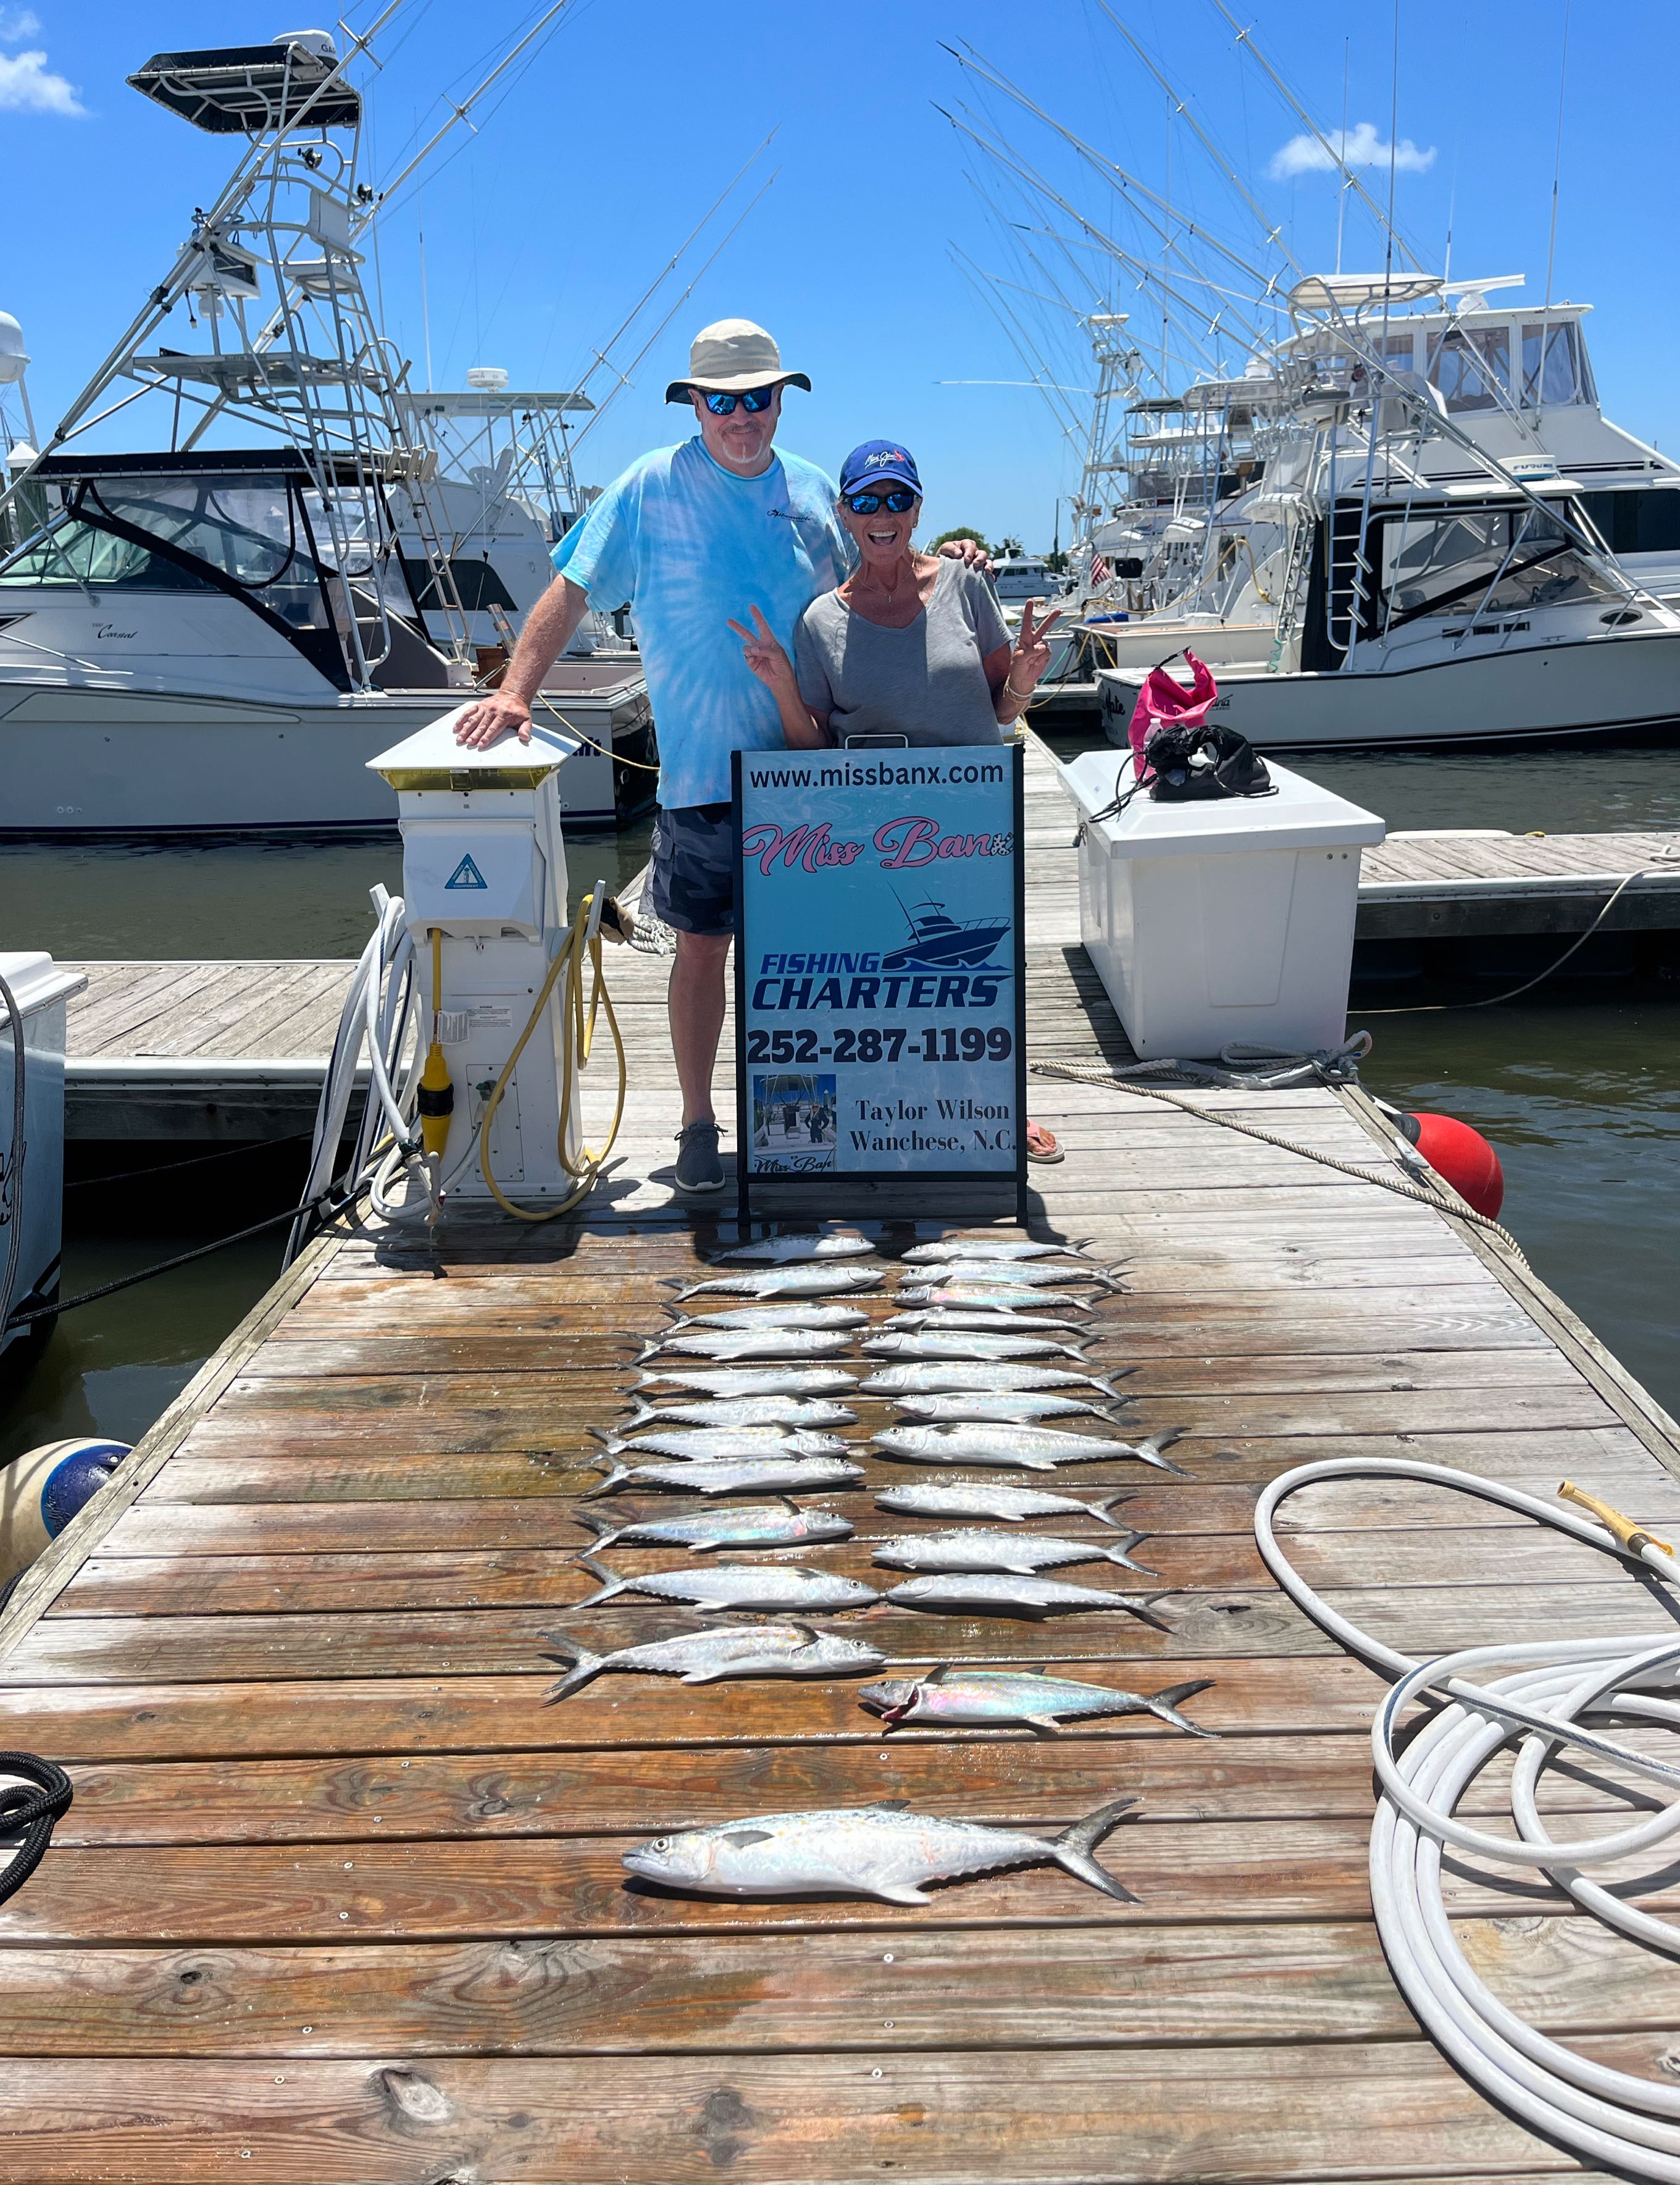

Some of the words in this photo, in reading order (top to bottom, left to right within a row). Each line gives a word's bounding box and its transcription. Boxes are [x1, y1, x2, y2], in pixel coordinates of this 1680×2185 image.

[750, 762, 1003, 787] www.missbanx.com
[742, 823, 865, 876] Miss
[873, 816, 1014, 870] Banx
[760, 952, 880, 975] FISHING
[752, 975, 1015, 1010] CHARTERS
[747, 1027, 1012, 1064] 252-287-1199
[855, 1099, 928, 1127] Taylor
[935, 1099, 1009, 1120] Wilson
[850, 1130, 965, 1154] Wanchese,
[973, 1130, 1017, 1151] N.C.
